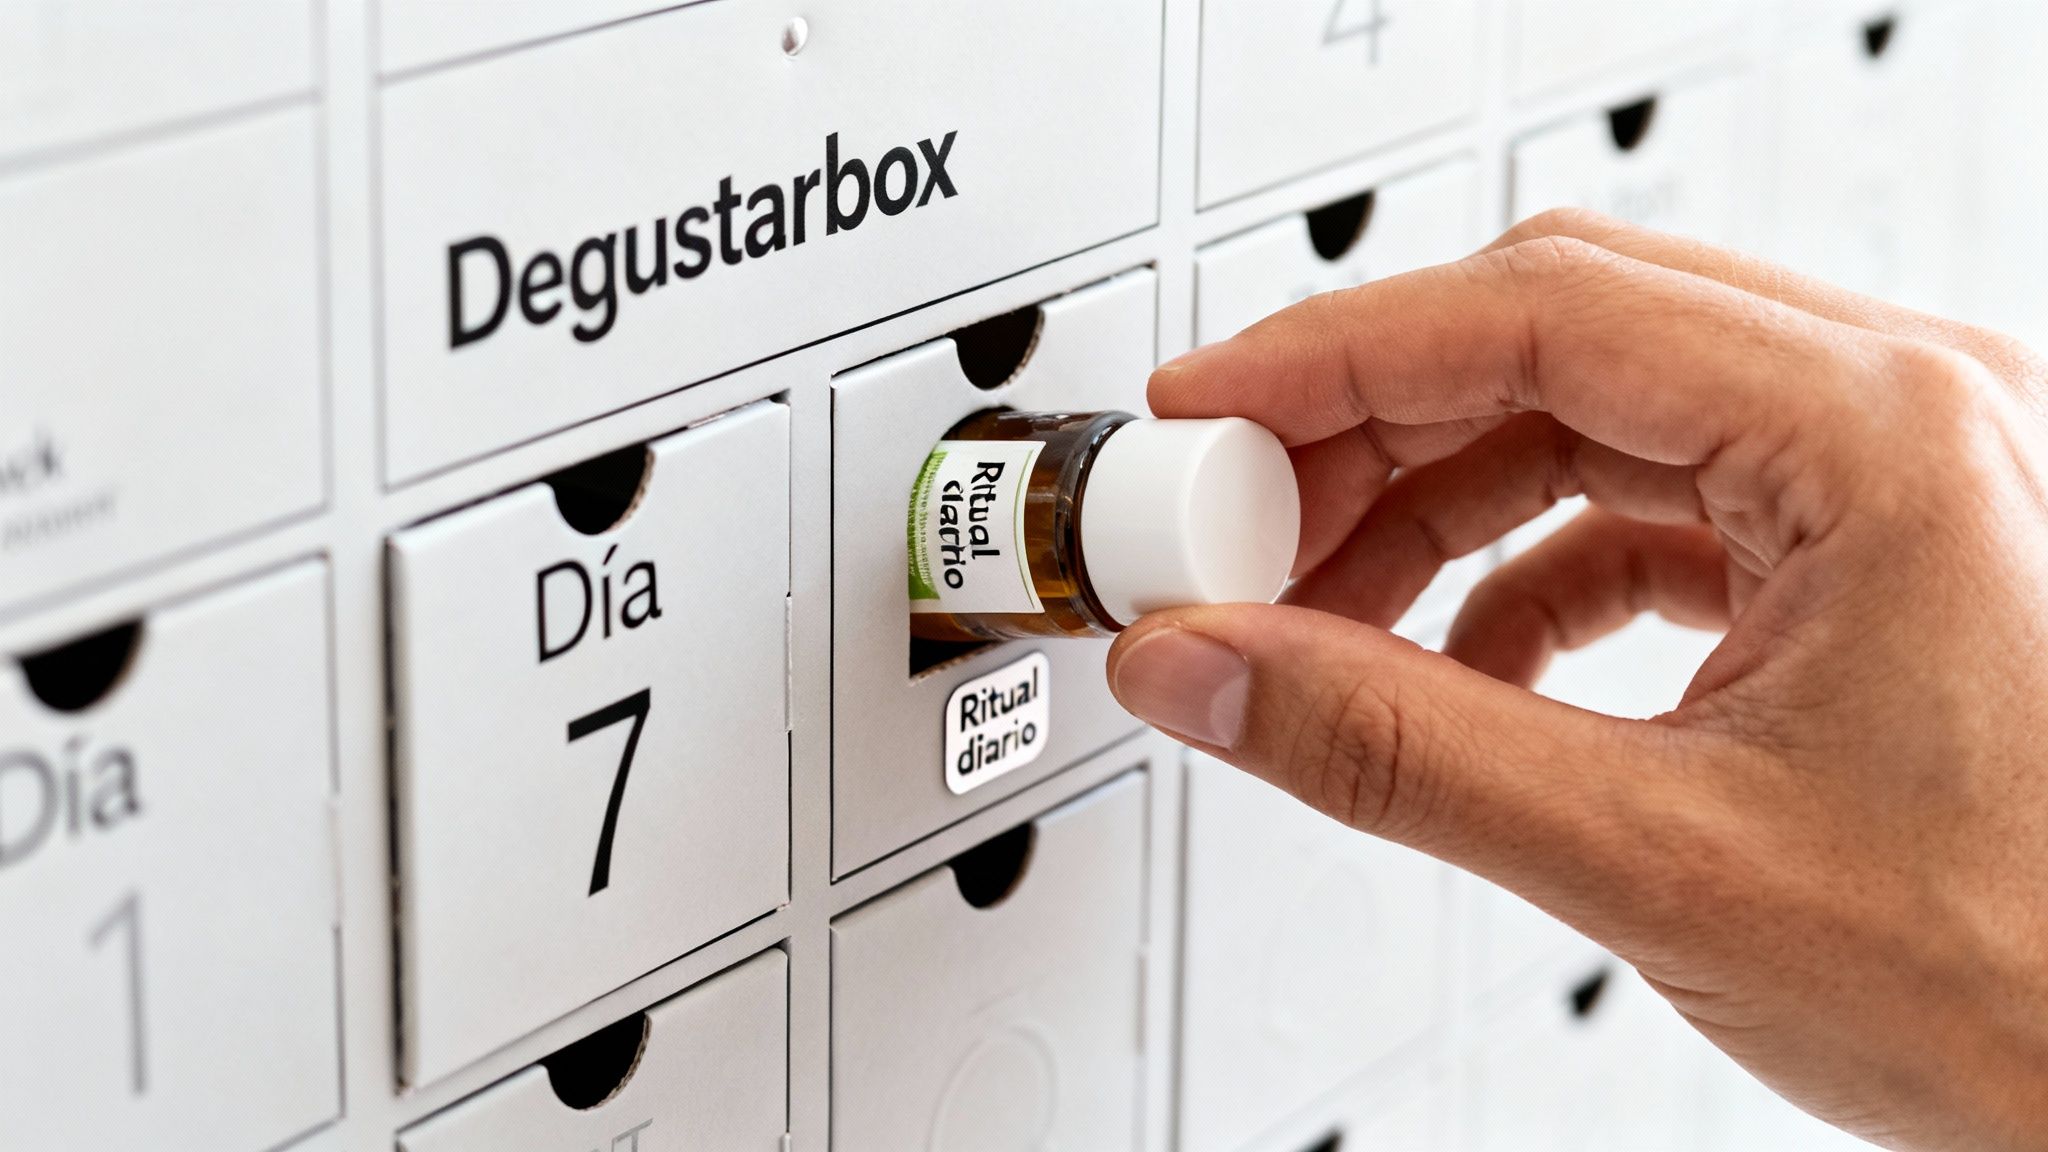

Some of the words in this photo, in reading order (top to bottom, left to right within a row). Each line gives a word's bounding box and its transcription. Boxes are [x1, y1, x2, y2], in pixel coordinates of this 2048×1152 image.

[446, 130, 959, 350] Degustarbox
[536, 543, 664, 664] Día
[957, 718, 1037, 776] diario
[960, 666, 1038, 733] Ritual
[566, 687, 652, 897] 7
[86, 888, 150, 1098] 1
